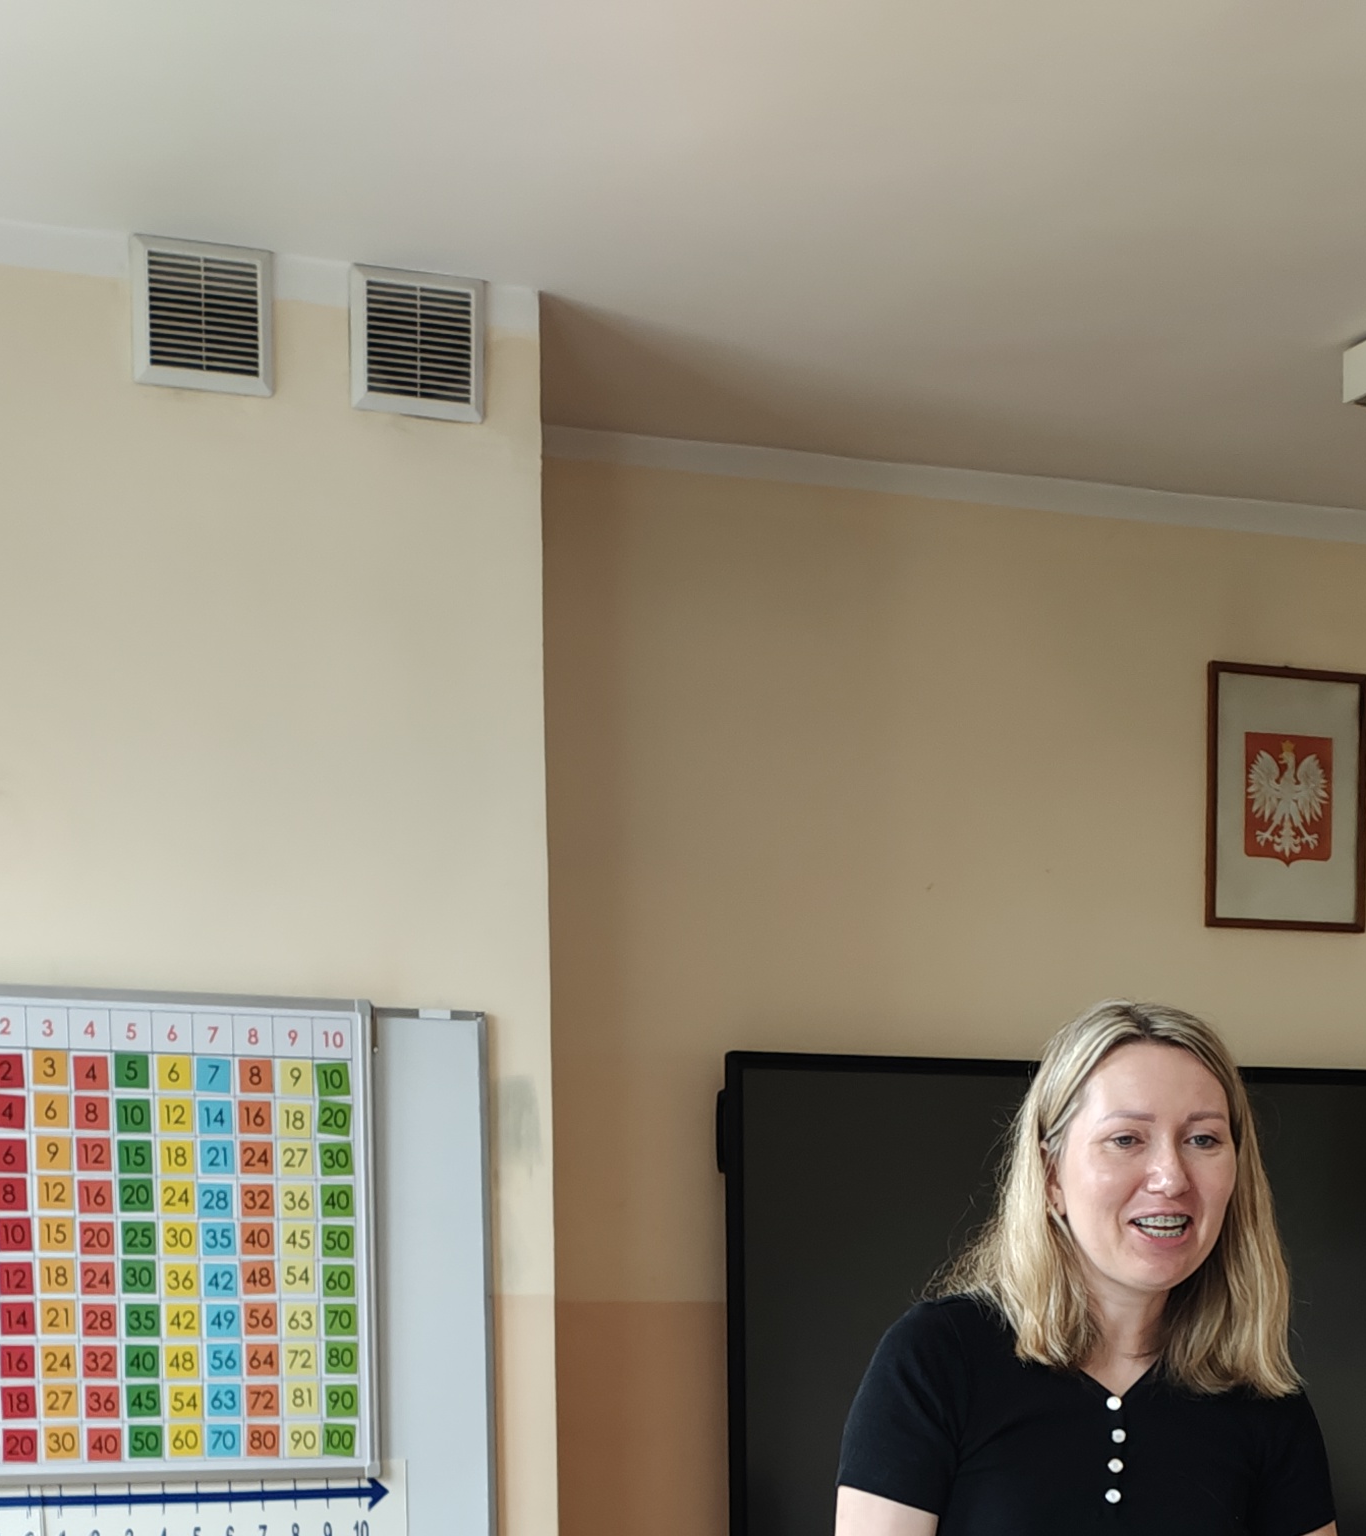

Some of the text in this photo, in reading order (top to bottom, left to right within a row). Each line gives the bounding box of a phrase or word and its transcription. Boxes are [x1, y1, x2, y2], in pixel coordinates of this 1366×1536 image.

[0, 1060, 12, 1081] 2
[43, 1057, 56, 1077] 3
[85, 1064, 97, 1081] 4
[125, 1060, 138, 1081] 5
[168, 1063, 180, 1082] 6
[208, 1065, 220, 1084] 7
[249, 1066, 262, 1086] 8
[290, 1067, 302, 1087] 9
[322, 1069, 343, 1089] 10
[2, 1102, 13, 1121] 4
[45, 1100, 57, 1120] 6
[85, 1102, 98, 1123] 8
[122, 1105, 144, 1126] 10
[165, 1104, 185, 1125] 12
[205, 1107, 225, 1127] 14
[245, 1107, 265, 1127] 16
[285, 1110, 305, 1130] 18
[322, 1107, 347, 1129] 20
[2, 1146, 15, 1165] 6
[47, 1142, 59, 1162] 9
[83, 1143, 104, 1164] 12
[124, 1146, 145, 1167] 15
[166, 1146, 187, 1167] 18
[207, 1146, 227, 1167] 21
[243, 1147, 269, 1167] 24
[283, 1147, 308, 1168] 27
[323, 1148, 349, 1169] 30
[2, 1183, 16, 1204] 8
[44, 1182, 65, 1202] 12
[84, 1186, 106, 1206] 16
[122, 1184, 149, 1205] 20
[164, 1186, 189, 1207] 24
[202, 1189, 229, 1210] 28
[244, 1189, 270, 1210] 32
[284, 1191, 310, 1211] 36
[324, 1190, 349, 1210] 40
[3, 1224, 25, 1244] 10
[45, 1223, 66, 1244] 15
[83, 1227, 110, 1248] 20
[125, 1227, 152, 1248] 25
[166, 1227, 192, 1248] 30
[205, 1228, 232, 1249] 35
[245, 1228, 270, 1248] 40
[286, 1230, 310, 1249] 45
[324, 1230, 350, 1251] 50
[5, 1269, 26, 1289] 12
[45, 1266, 68, 1286] 18
[84, 1268, 110, 1288] 24
[125, 1267, 152, 1287] 30
[168, 1270, 194, 1290] 36
[208, 1271, 233, 1291] 42
[246, 1267, 271, 1287] 48
[285, 1266, 310, 1285] 54
[326, 1270, 351, 1291] 60
[7, 1310, 27, 1328] 14
[47, 1307, 69, 1327] 21
[86, 1310, 113, 1330] 28
[129, 1310, 155, 1331] 35
[170, 1310, 195, 1330] 42
[211, 1310, 235, 1329] 49
[247, 1309, 273, 1329] 56
[288, 1310, 313, 1330] 63
[328, 1309, 352, 1329] 70
[7, 1352, 28, 1372] 16
[45, 1352, 71, 1372] 24
[86, 1351, 113, 1372] 32
[129, 1351, 155, 1372] 40
[169, 1351, 194, 1371] 48
[211, 1350, 237, 1370] 56
[249, 1350, 274, 1369] 64
[288, 1349, 312, 1369] 72
[328, 1347, 354, 1368] 80
[8, 1392, 30, 1412] 18
[47, 1390, 73, 1411] 27
[89, 1392, 115, 1412] 36
[131, 1390, 157, 1411] 45
[172, 1392, 198, 1412] 54
[211, 1390, 236, 1410] 63
[250, 1390, 274, 1410] 72
[292, 1388, 312, 1408] 81
[328, 1390, 354, 1410] 90
[6, 1435, 37, 1455] 20
[48, 1432, 75, 1453] 30
[91, 1434, 118, 1454] 40
[132, 1431, 159, 1452] 50
[172, 1429, 198, 1450] 60
[211, 1430, 236, 1450] 70
[250, 1430, 276, 1450] 80
[291, 1430, 316, 1450] 90
[326, 1429, 353, 1450] 100
